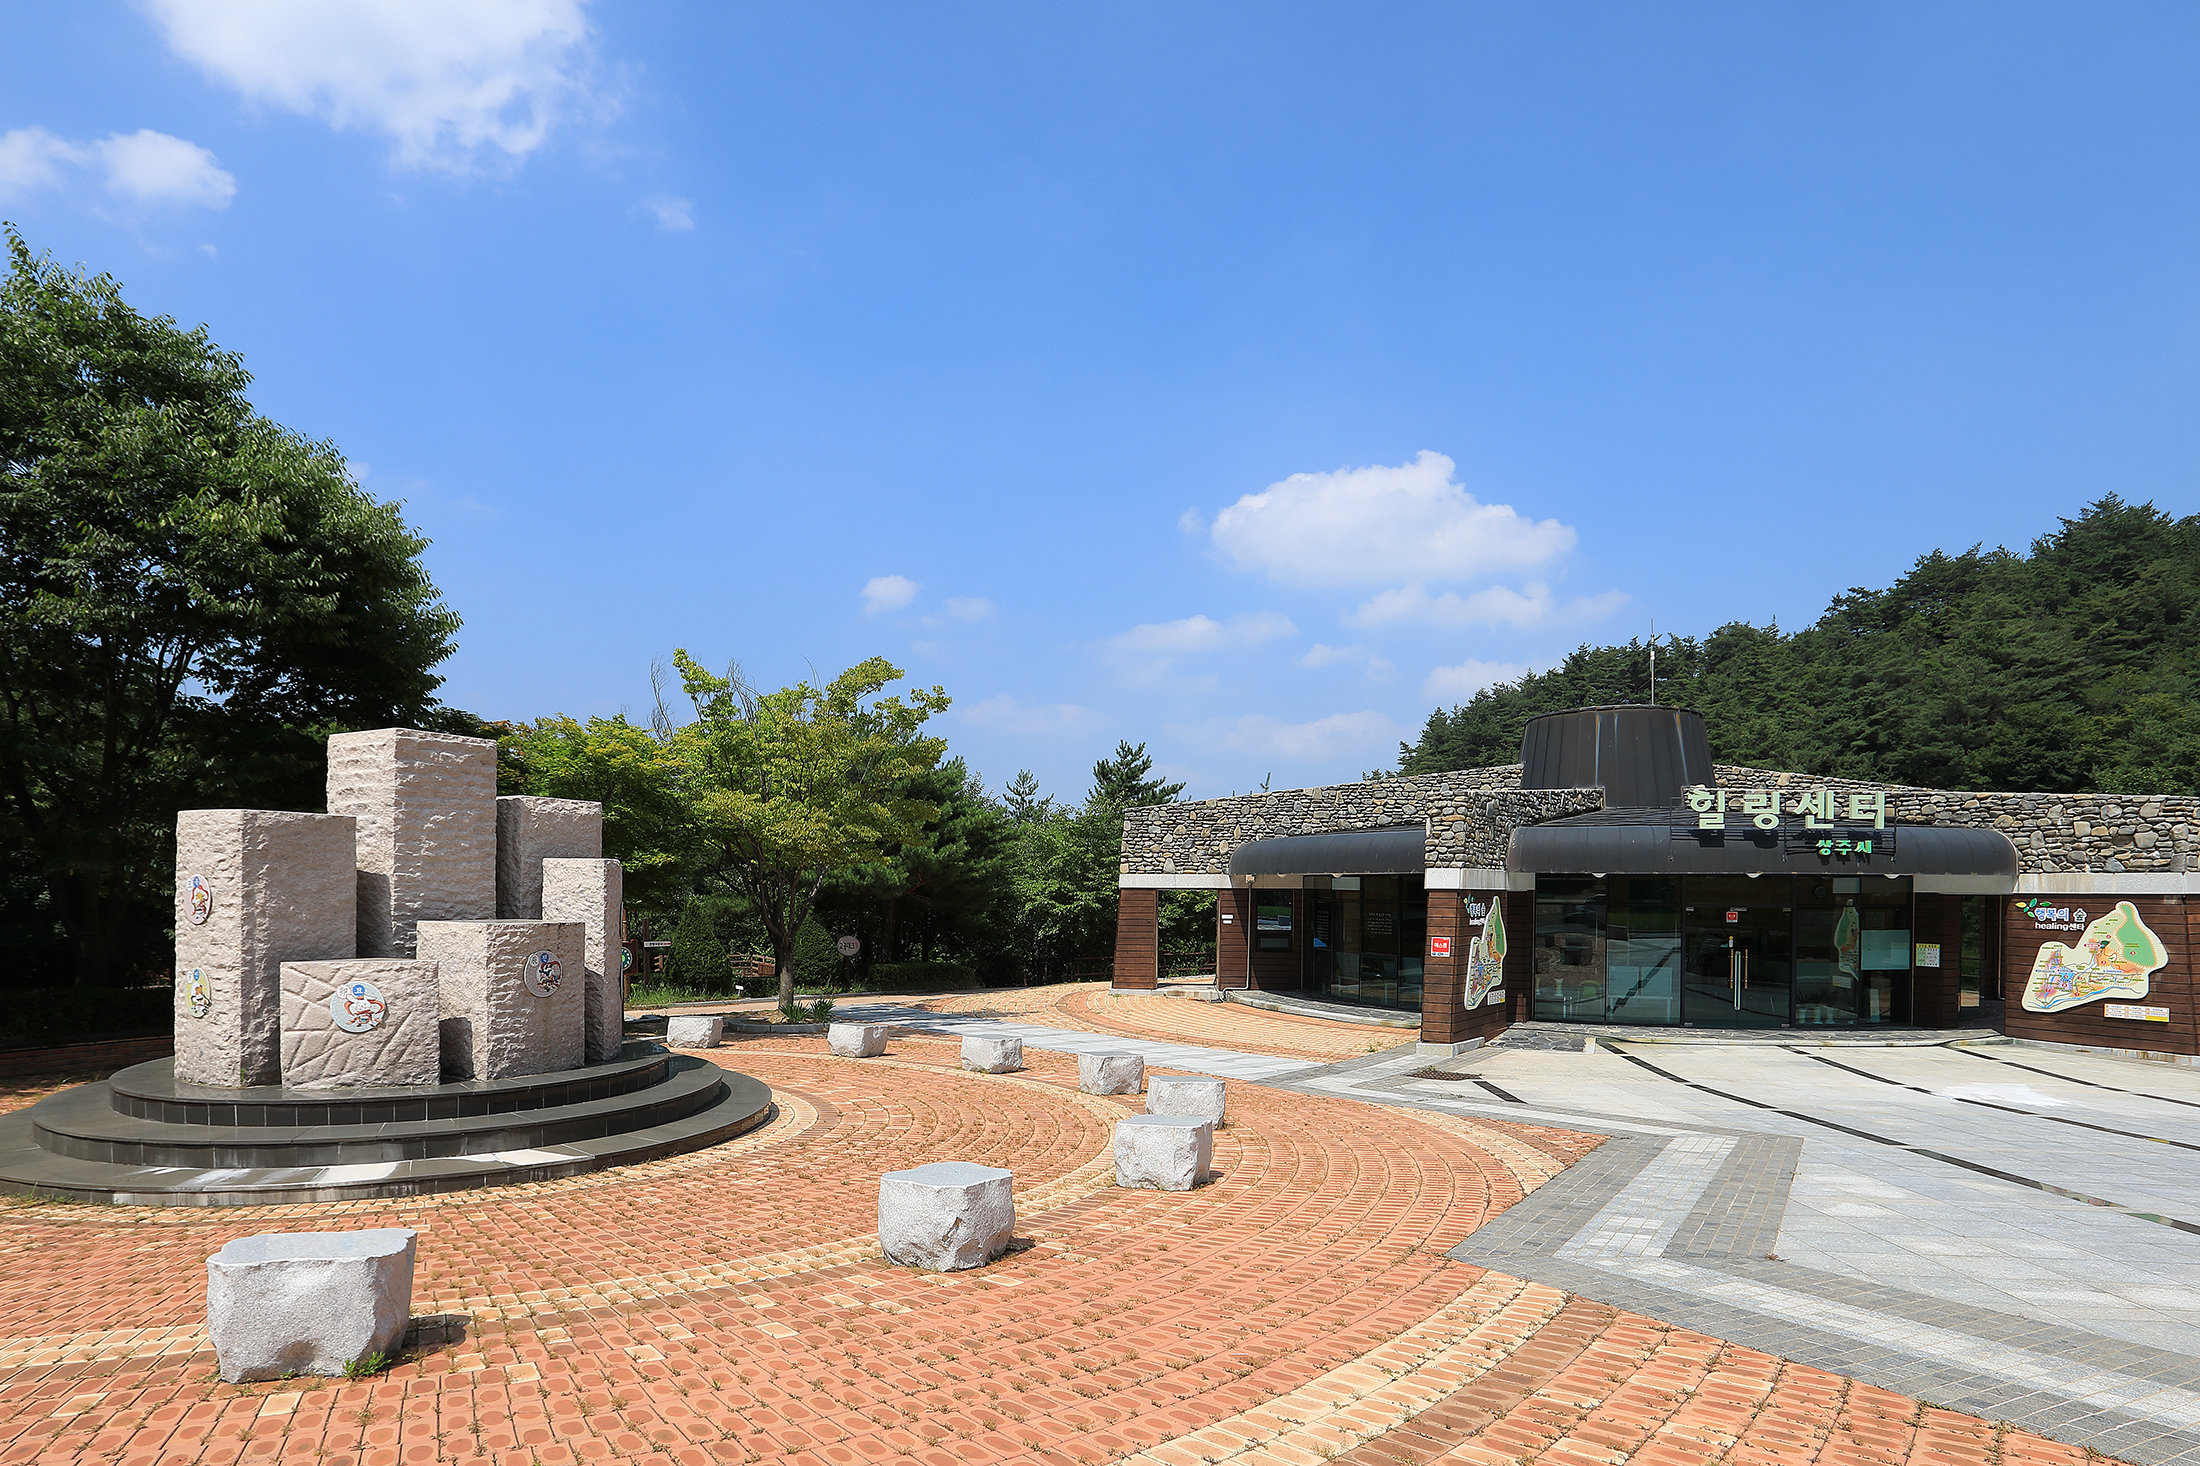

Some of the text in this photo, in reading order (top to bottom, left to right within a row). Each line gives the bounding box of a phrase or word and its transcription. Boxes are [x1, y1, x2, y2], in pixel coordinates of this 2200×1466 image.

[1687, 788, 1886, 830] 힐링센터
[1815, 839, 1873, 856] 상주시
[2034, 907, 2088, 922] 행복의 숲
